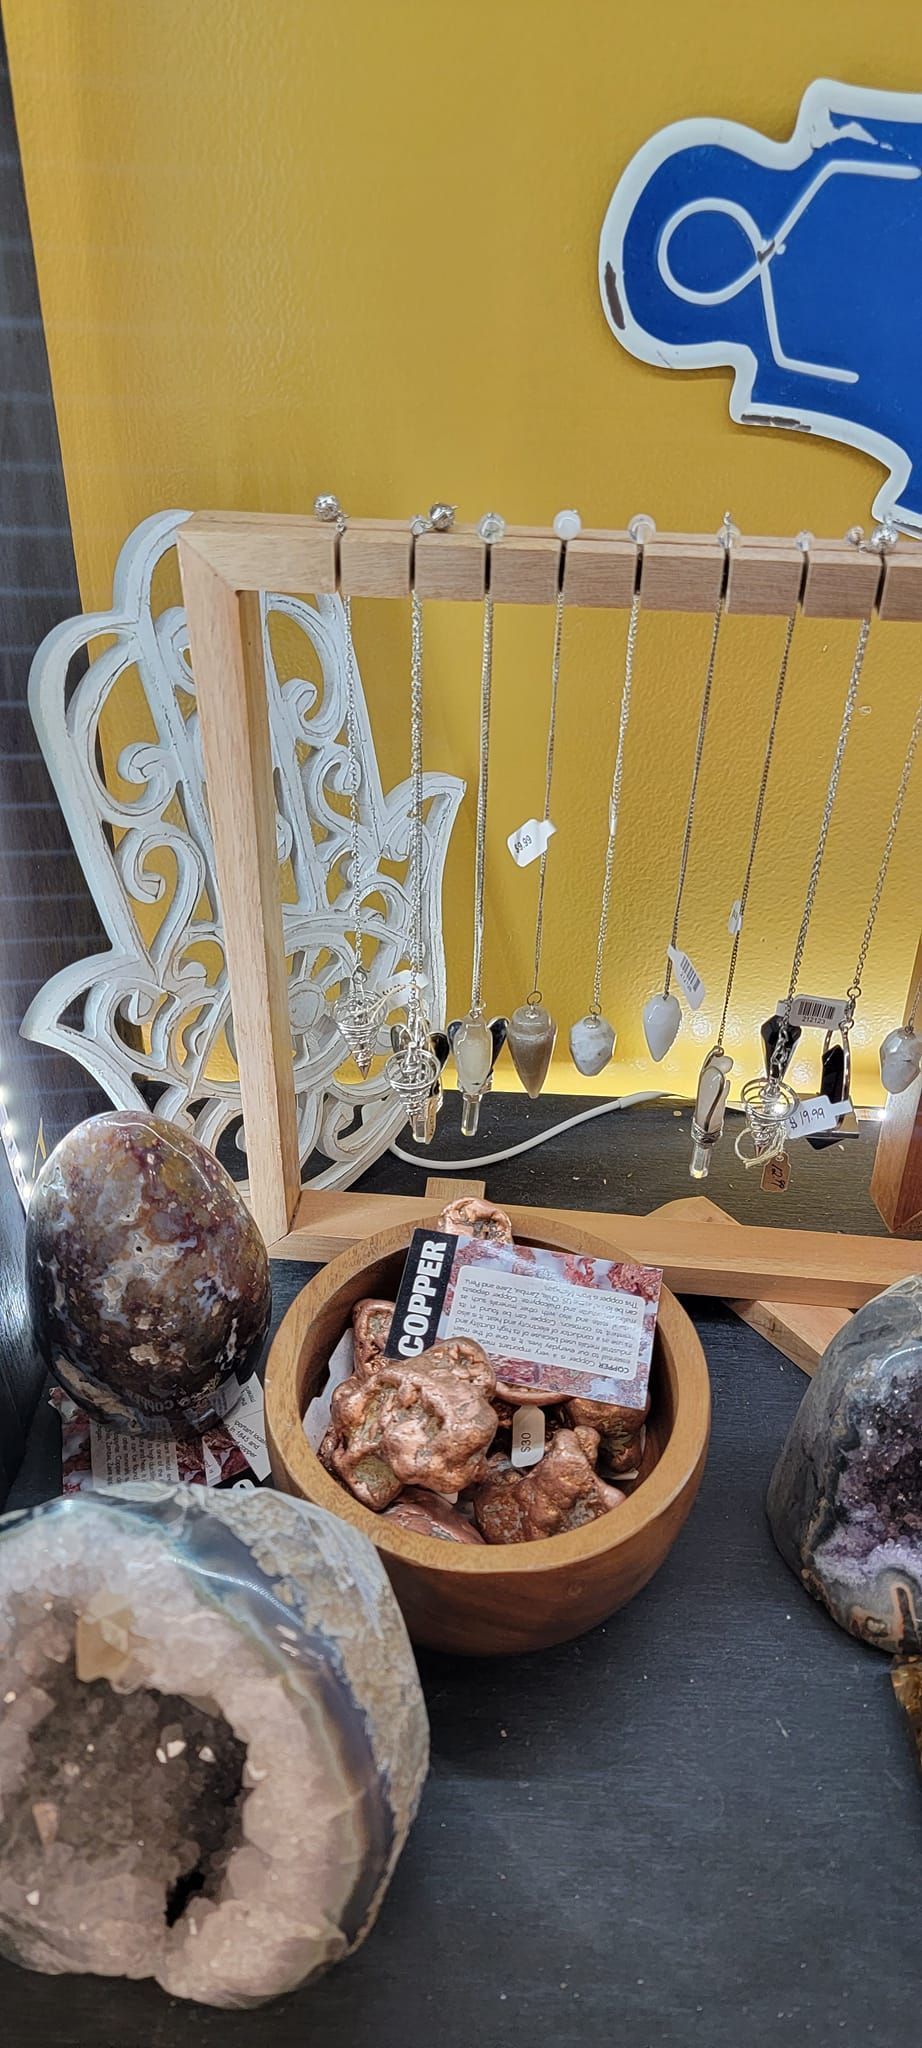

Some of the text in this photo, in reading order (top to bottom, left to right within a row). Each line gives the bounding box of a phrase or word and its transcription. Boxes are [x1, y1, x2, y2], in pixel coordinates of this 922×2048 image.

[801, 1015, 826, 1025] 212123
[398, 1240, 448, 1357] COPPER
[521, 1432, 532, 1453] $30
